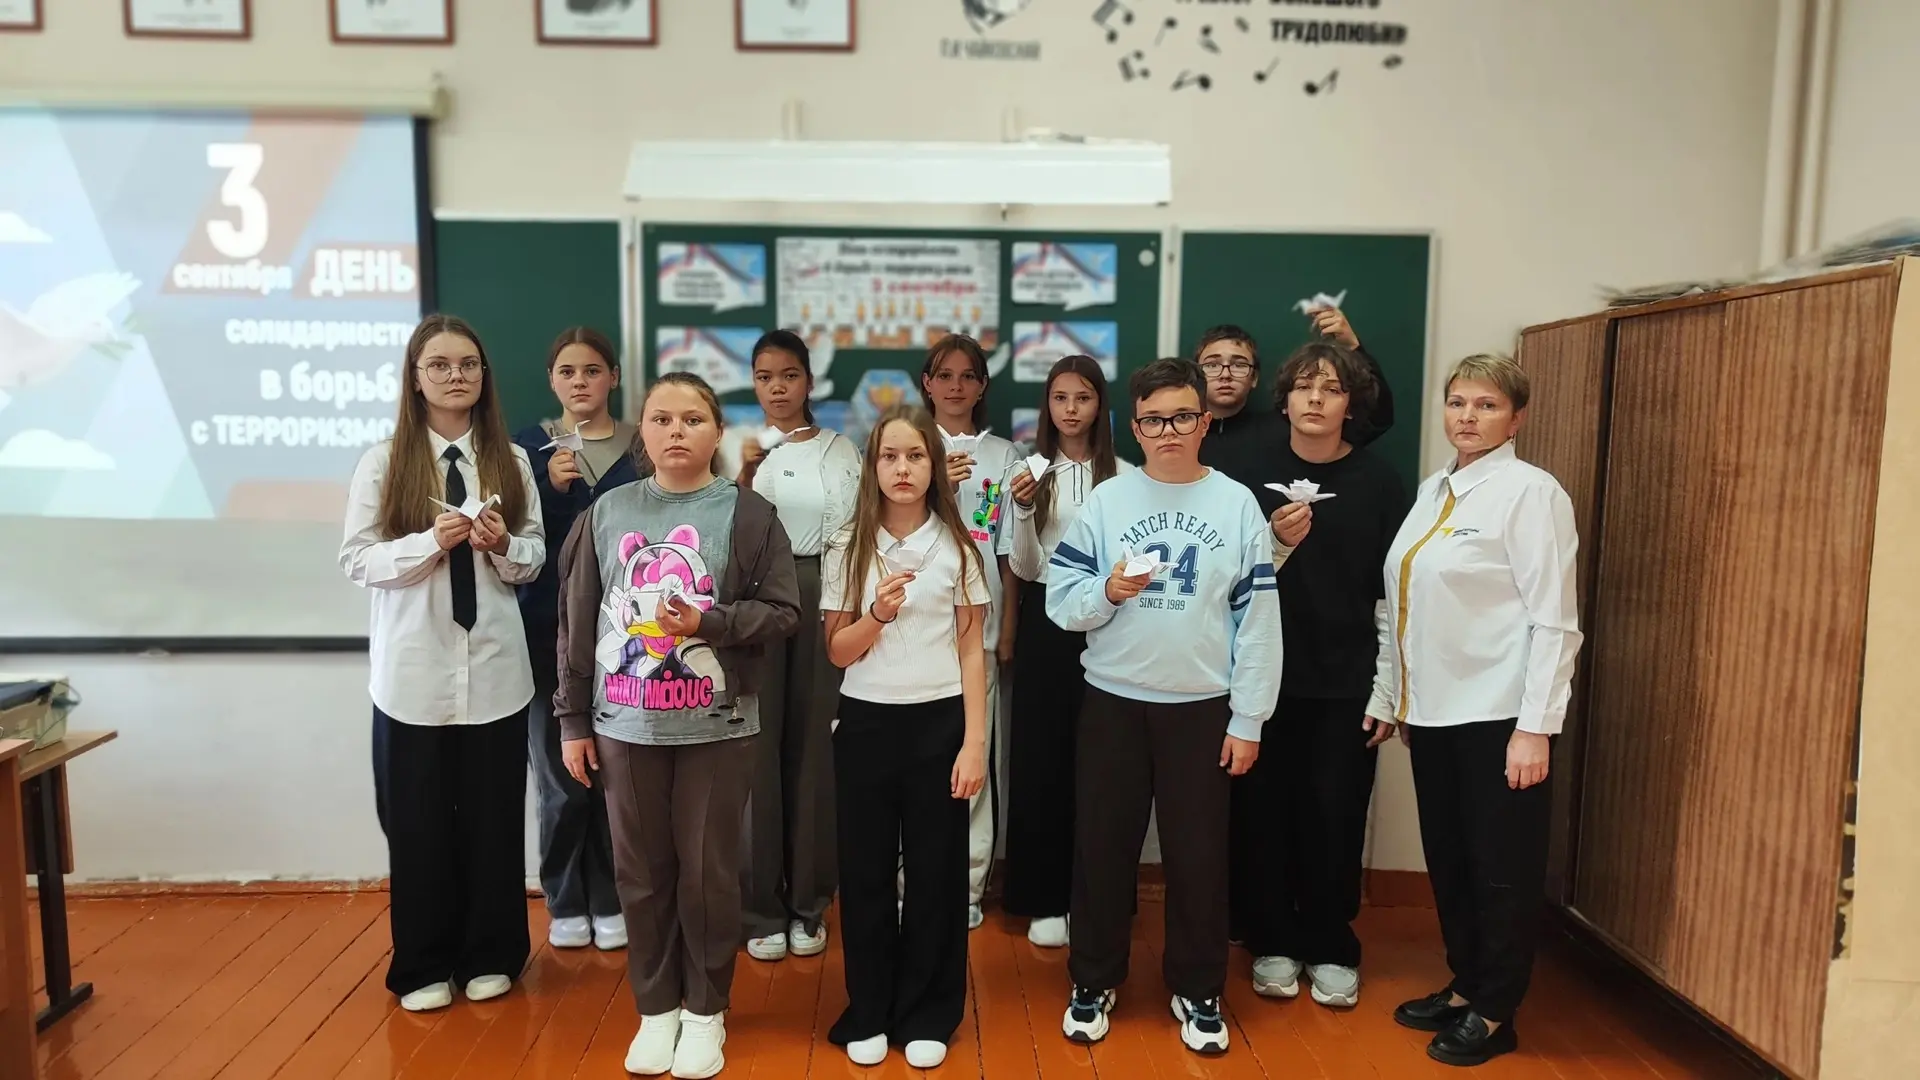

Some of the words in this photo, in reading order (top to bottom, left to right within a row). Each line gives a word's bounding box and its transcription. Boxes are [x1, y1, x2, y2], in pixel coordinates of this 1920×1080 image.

[206, 143, 268, 258] 3
[173, 258, 292, 295] сентября
[310, 248, 416, 297] ДЕНЬ
[260, 369, 283, 400] в
[290, 360, 399, 410] борьб
[191, 419, 208, 445] с
[212, 413, 395, 447] ТЕРРОРИЗМО
[1174, 512, 1225, 551] READY
[1139, 597, 1164, 609] SINCE
[1166, 600, 1186, 611] 1989
